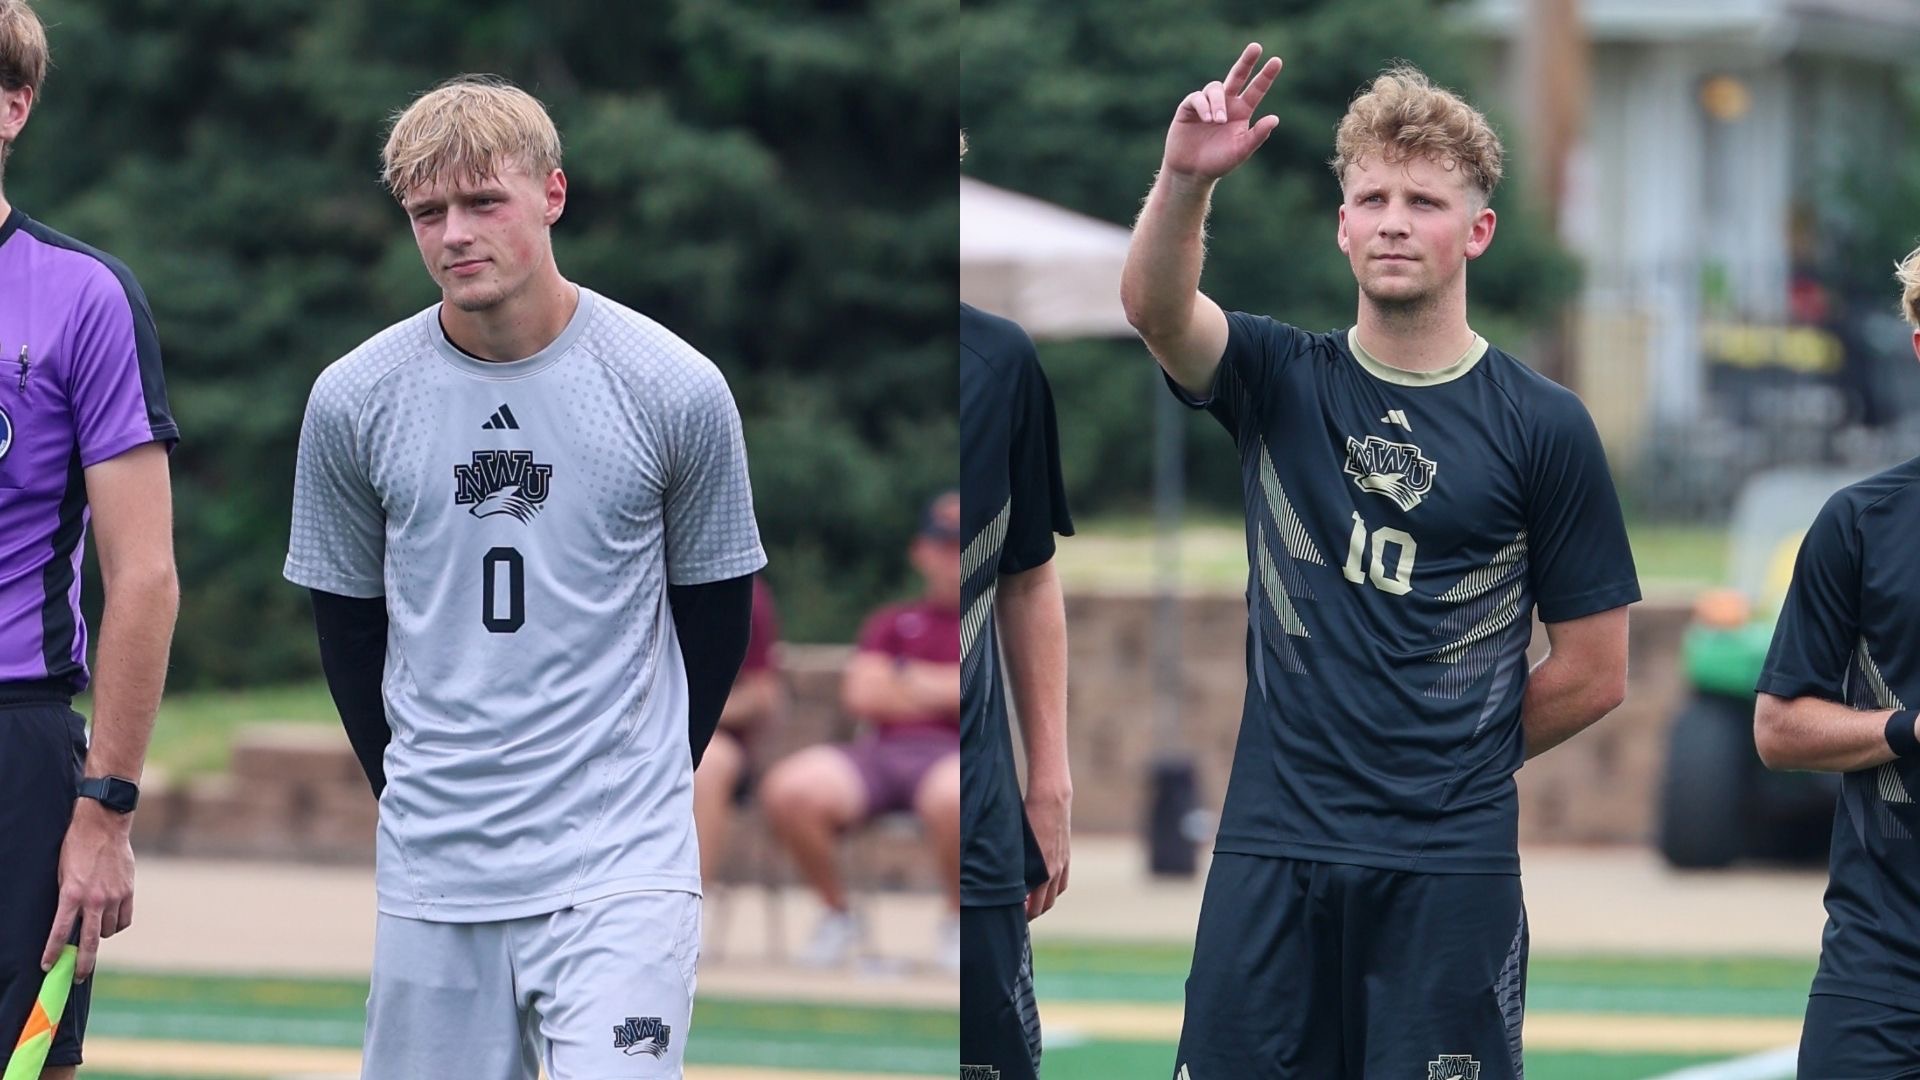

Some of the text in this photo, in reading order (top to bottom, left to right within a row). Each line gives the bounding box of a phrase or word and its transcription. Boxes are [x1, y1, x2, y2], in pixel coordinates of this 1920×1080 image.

[455, 451, 552, 504] NWU
[1344, 436, 1437, 495] NWU
[1343, 511, 1417, 595] 10
[483, 547, 525, 633] 0
[613, 1017, 670, 1048] NWU
